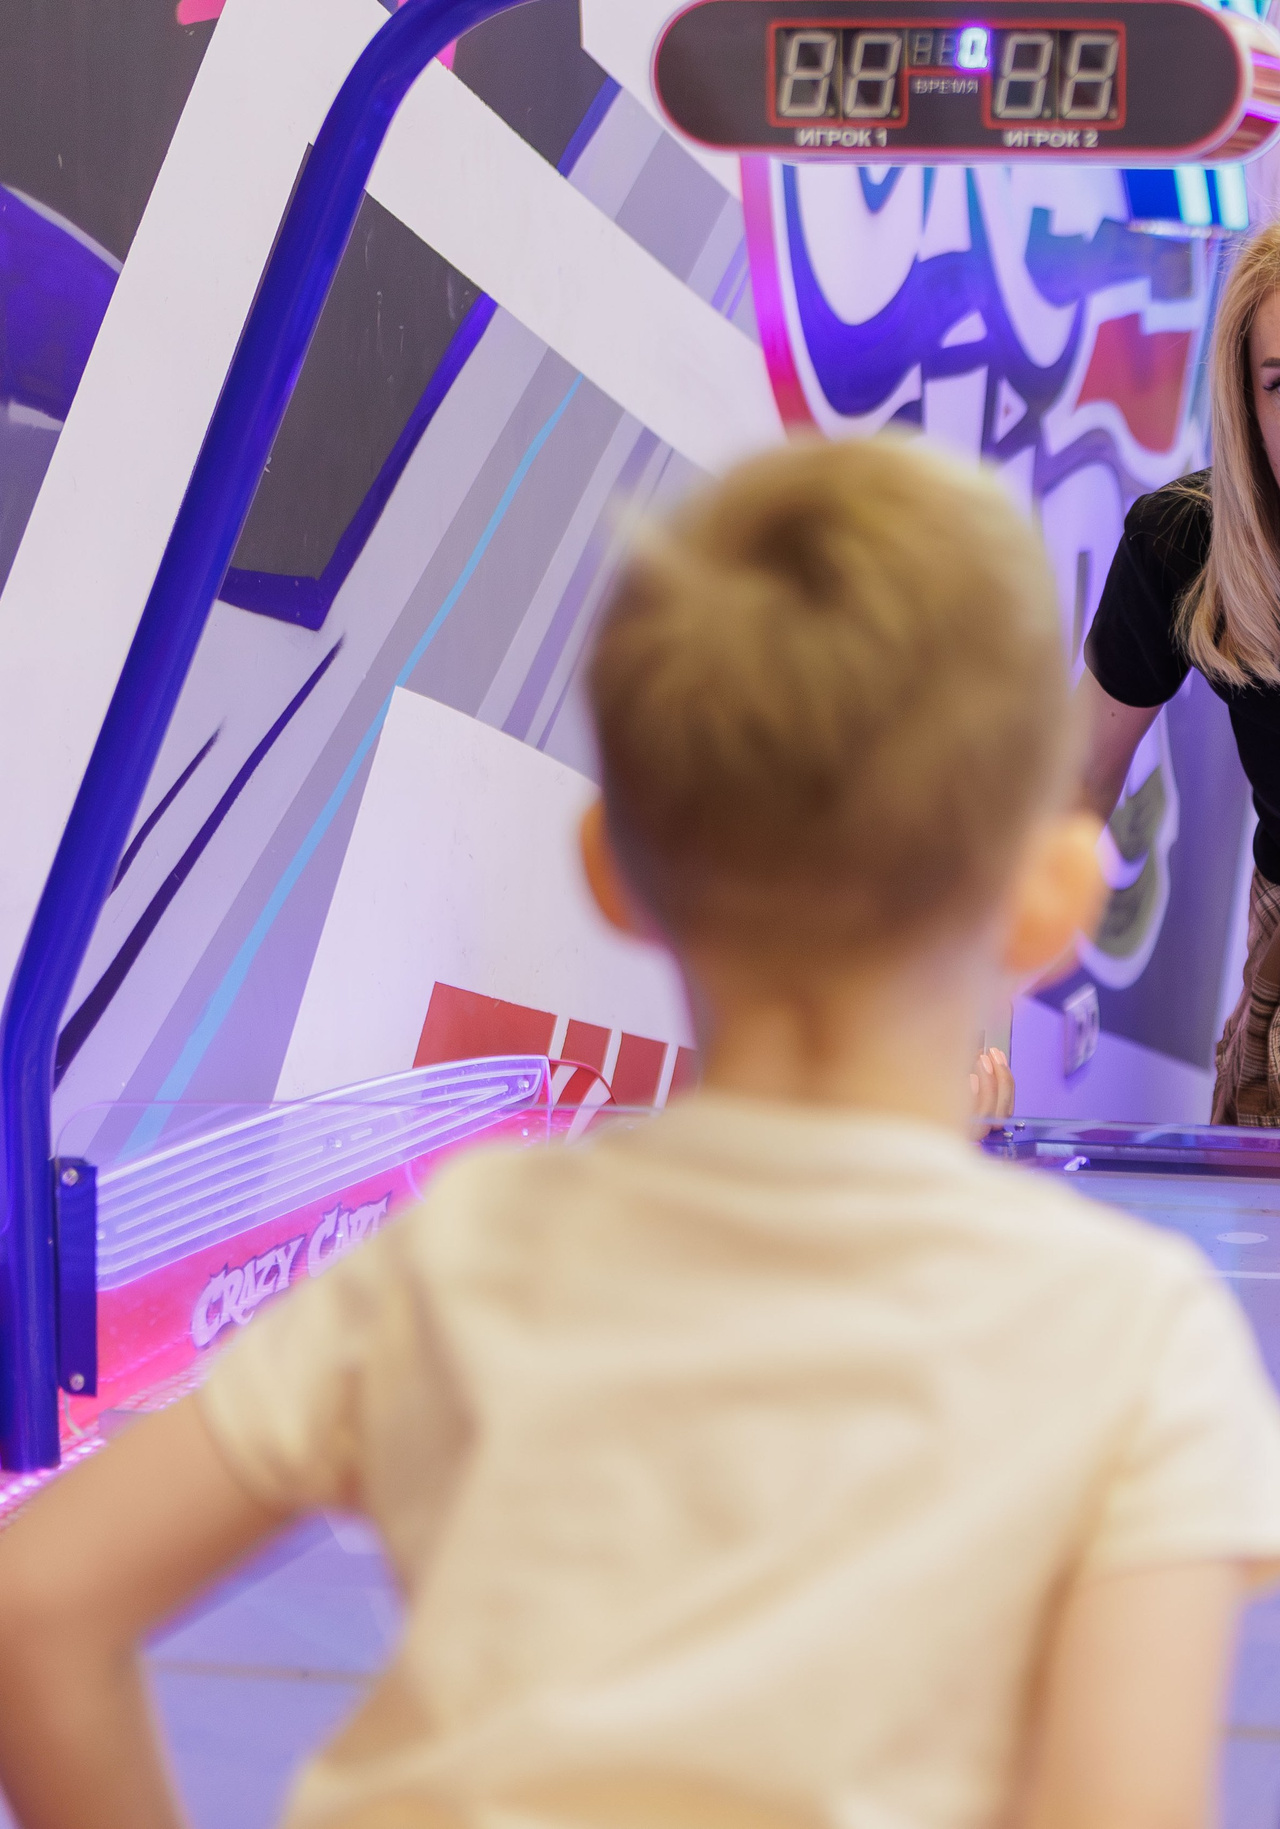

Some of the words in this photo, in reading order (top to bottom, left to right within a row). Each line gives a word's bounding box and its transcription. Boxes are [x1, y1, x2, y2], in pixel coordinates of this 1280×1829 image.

[913, 78, 979, 95] ВРЕМЯ
[796, 128, 872, 147] ИГРОК
[875, 128, 888, 147] 1
[1003, 128, 1080, 147] ИГРОК
[1083, 128, 1099, 147] 2
[190, 1233, 307, 1350] CRAZY
